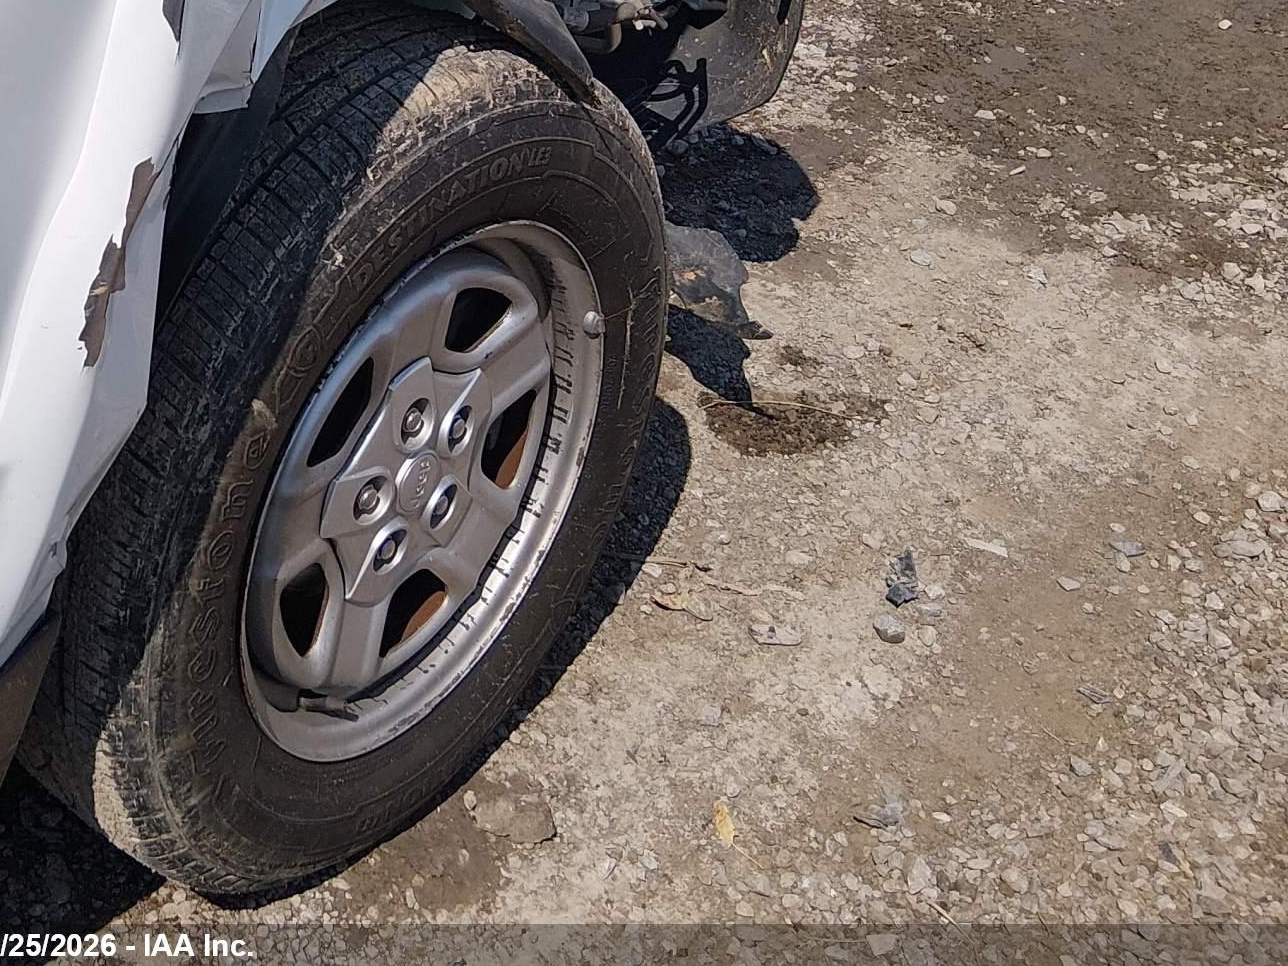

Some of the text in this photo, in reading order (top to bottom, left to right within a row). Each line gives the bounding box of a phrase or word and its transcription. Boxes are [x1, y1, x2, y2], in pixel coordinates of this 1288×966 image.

[351, 148, 527, 289] DESTINATION
[409, 458, 431, 509] Jeep
[187, 430, 271, 777] Firestone
